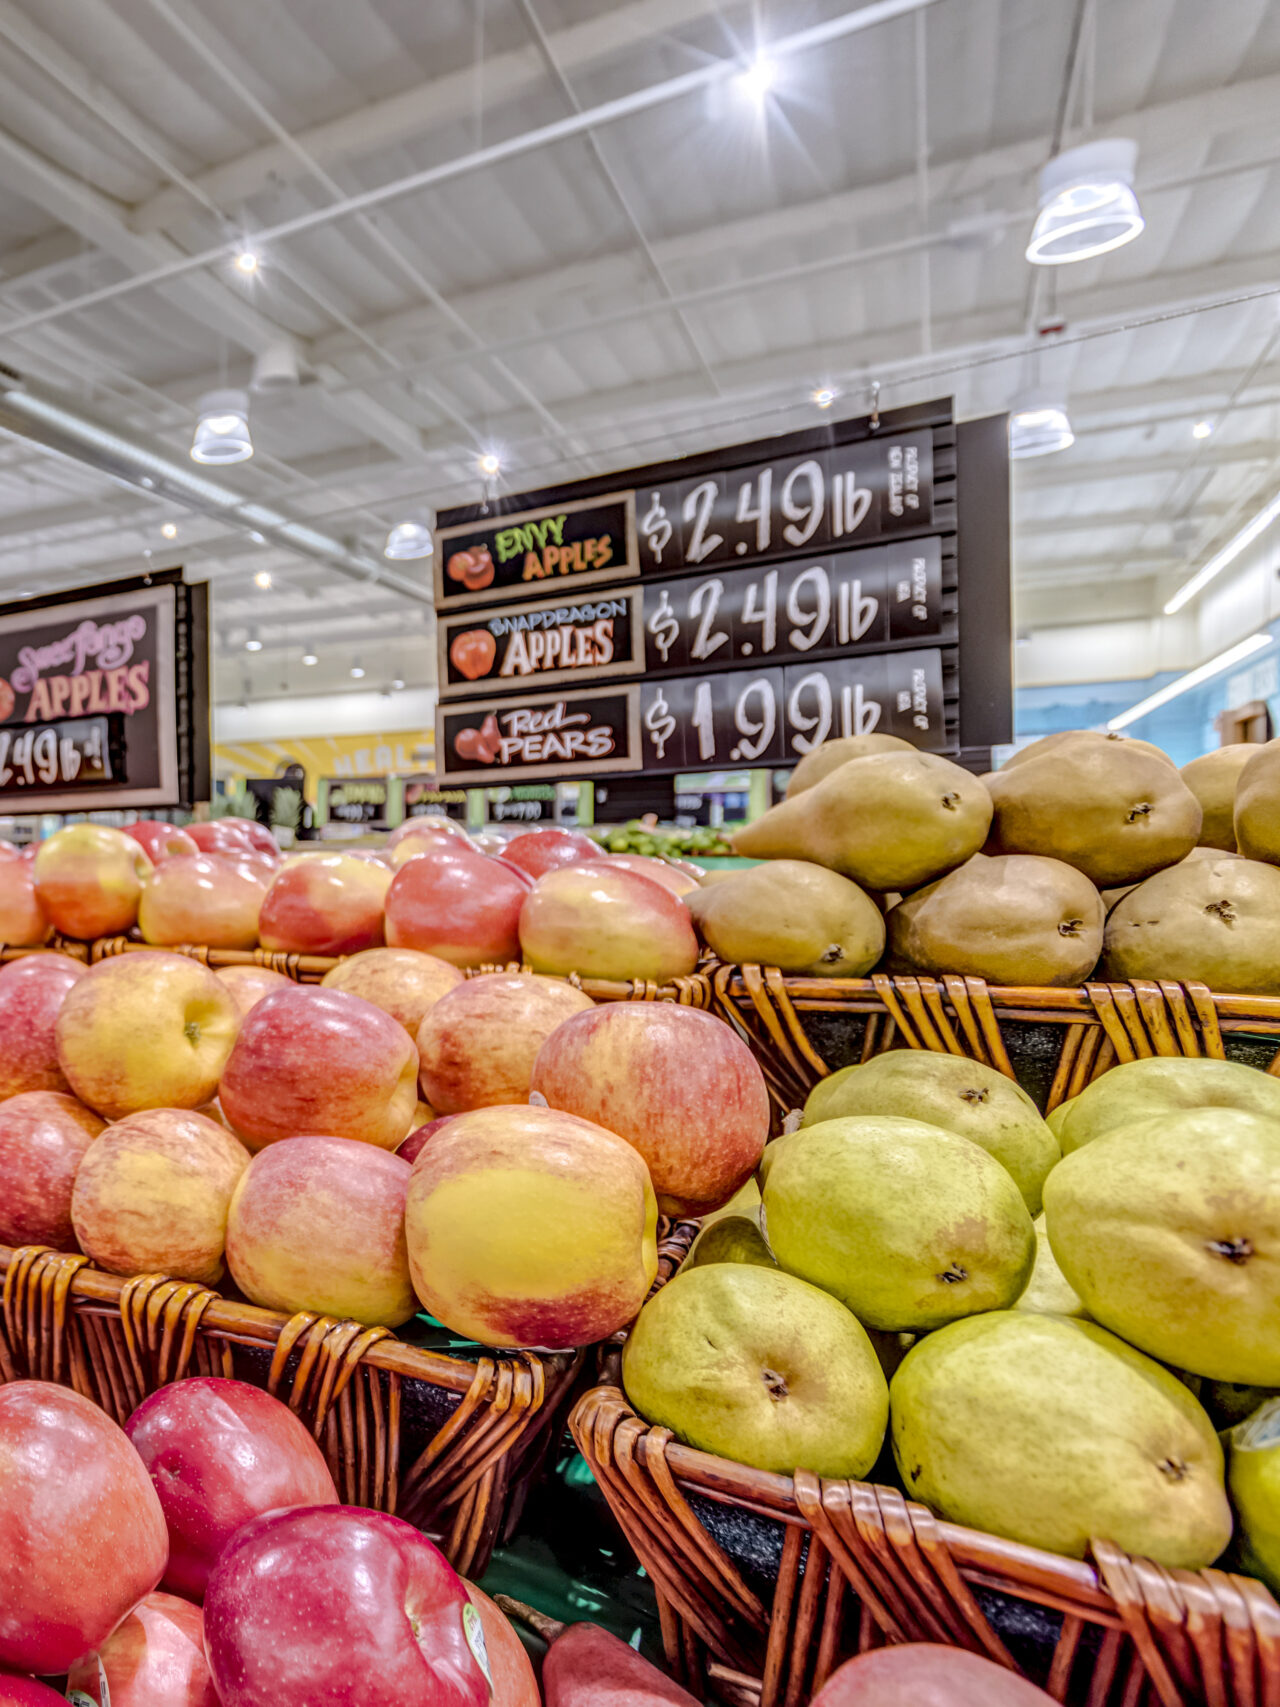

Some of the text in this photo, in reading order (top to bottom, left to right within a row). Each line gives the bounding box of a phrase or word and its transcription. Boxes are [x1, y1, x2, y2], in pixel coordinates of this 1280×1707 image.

[494, 515, 567, 564] ENVY
[522, 534, 614, 581] APPLES
[488, 599, 627, 637] SNAPDRAGON
[499, 619, 615, 677] APPLES
[24, 659, 150, 723] APPLES
[500, 701, 591, 737] Red
[497, 725, 616, 765] PEARS
